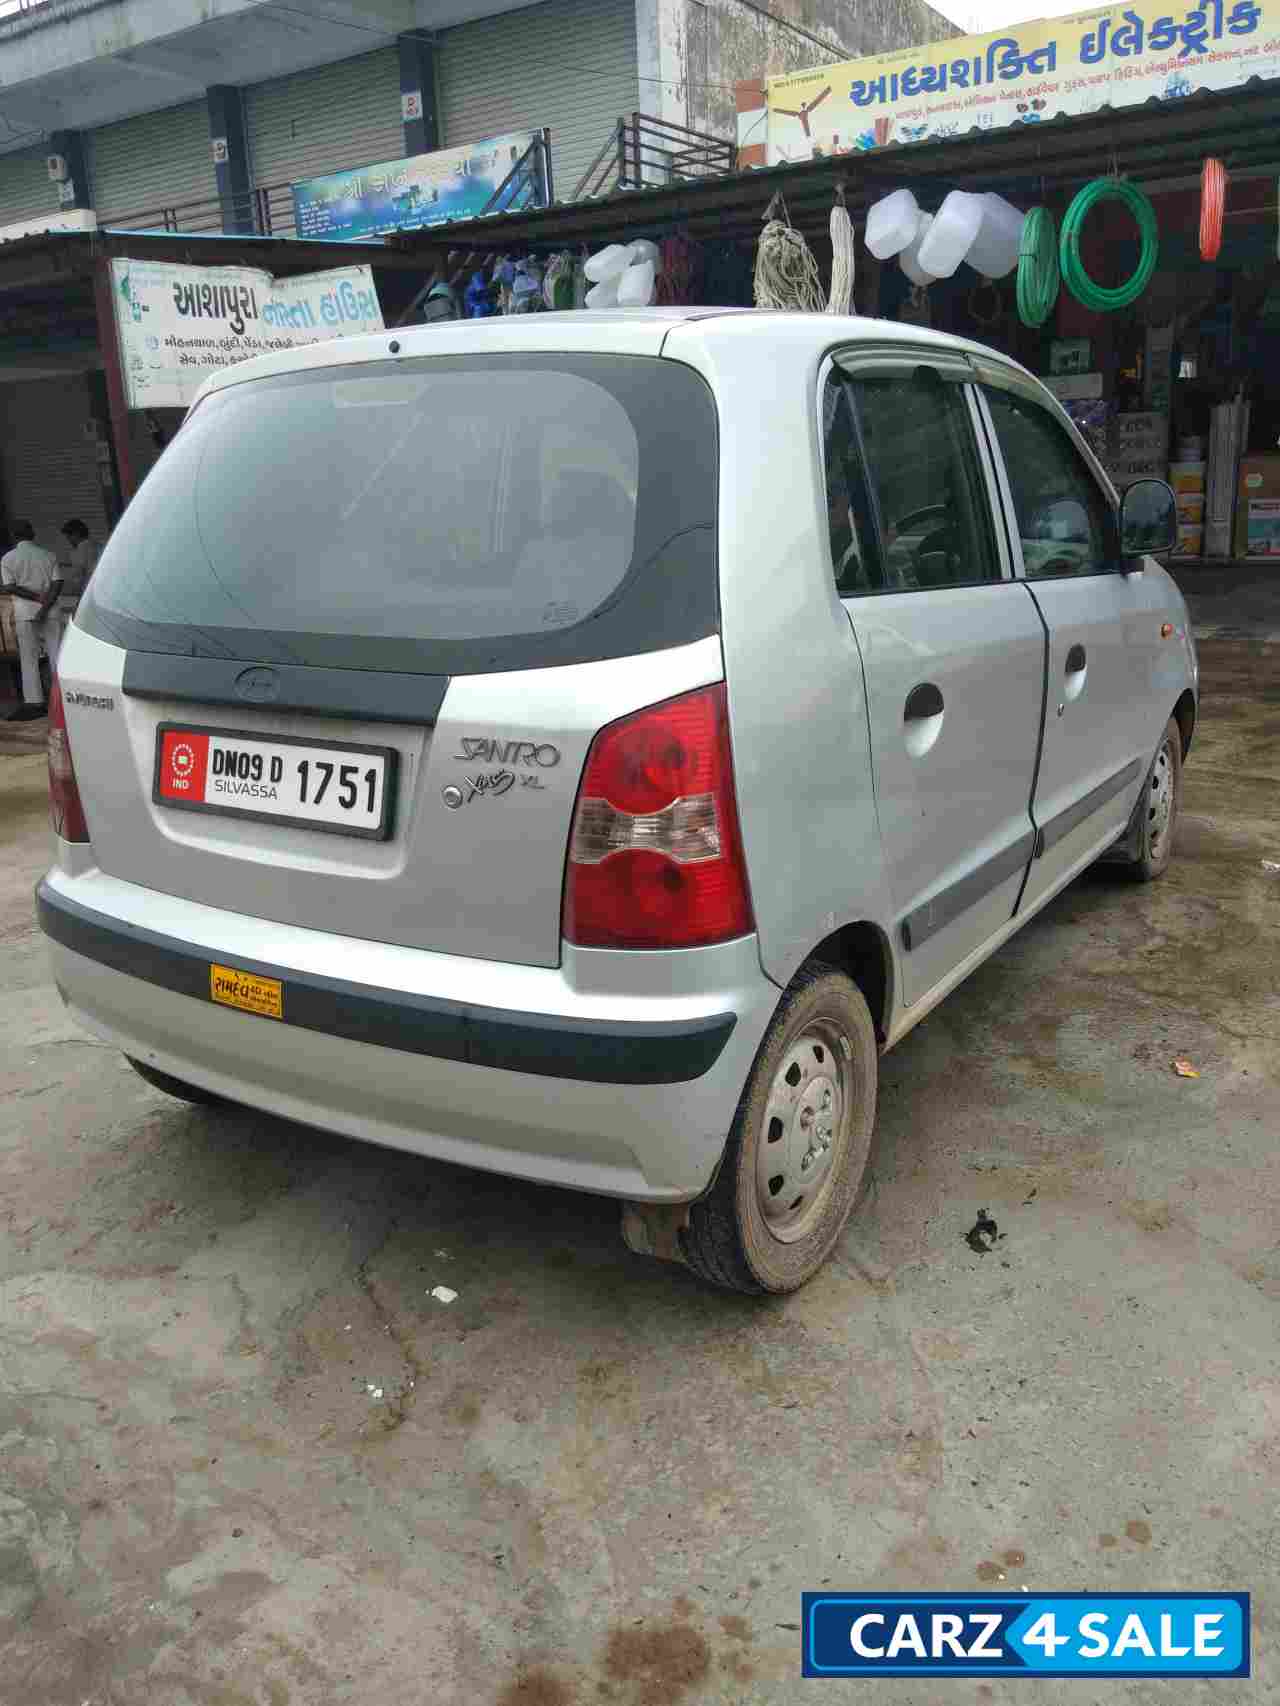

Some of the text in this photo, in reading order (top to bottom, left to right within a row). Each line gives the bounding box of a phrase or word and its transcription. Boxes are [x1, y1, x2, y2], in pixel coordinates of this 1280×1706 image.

[172, 281, 258, 335] આશાપુરા
[453, 738, 561, 768] SANTRO
[172, 778, 189, 790] IND
[212, 749, 377, 813] DN09 D 1751
[214, 779, 279, 800] SILVASSA
